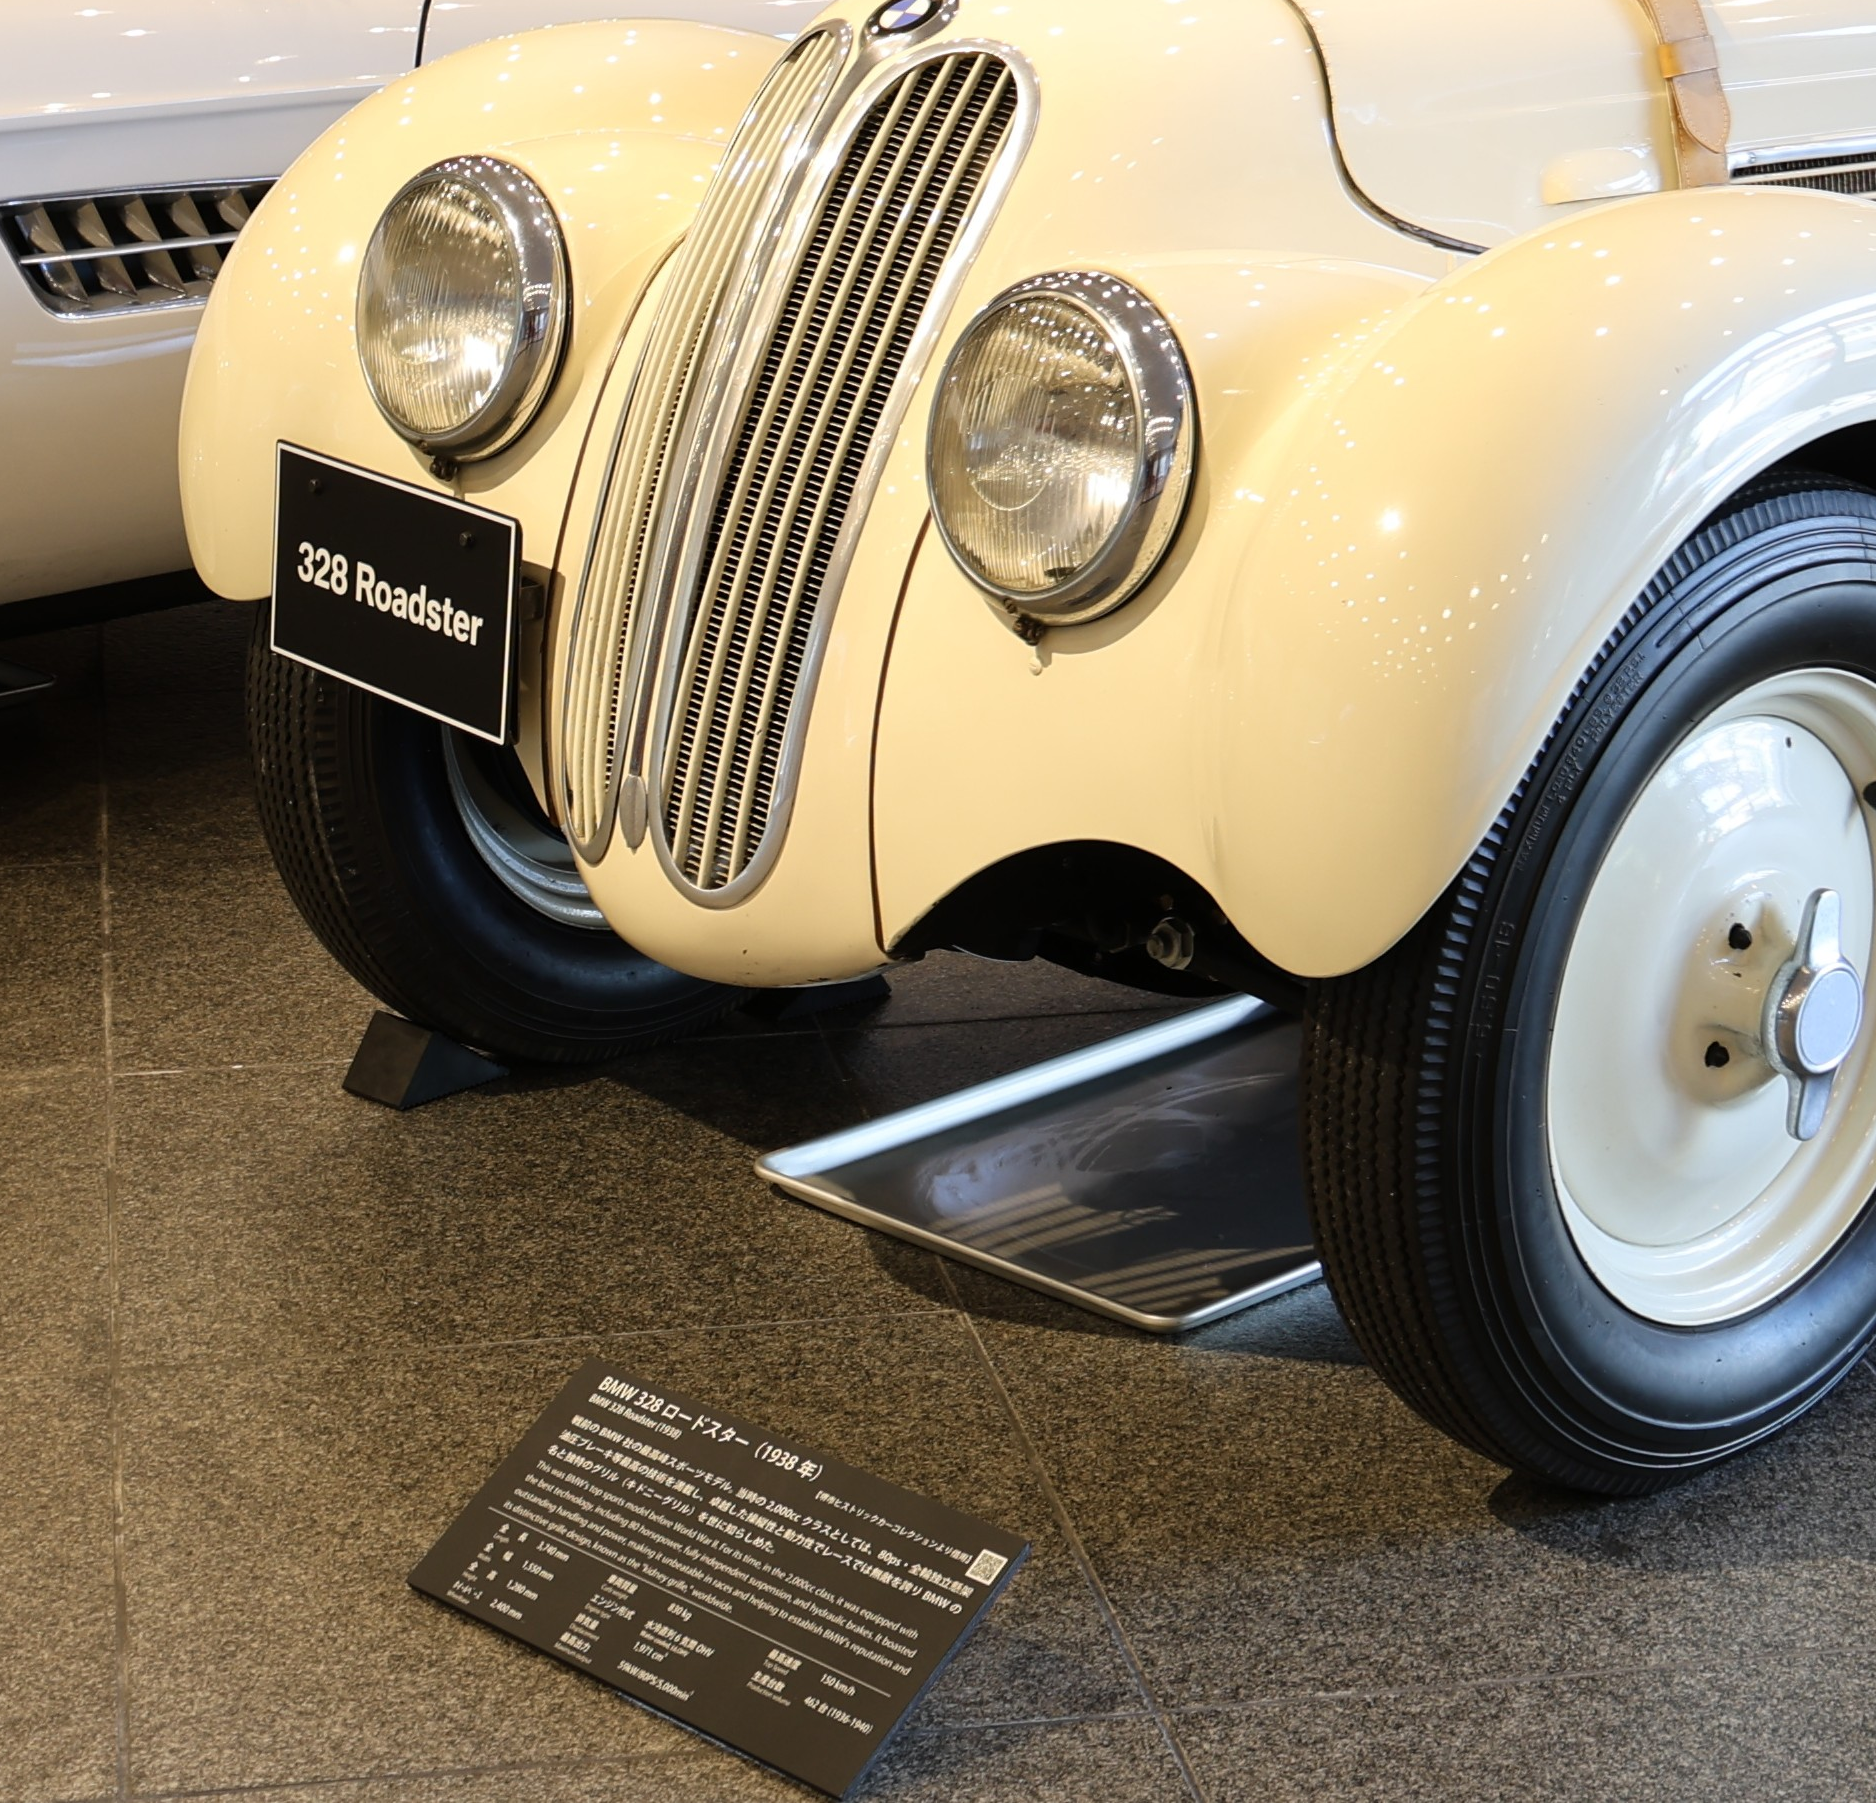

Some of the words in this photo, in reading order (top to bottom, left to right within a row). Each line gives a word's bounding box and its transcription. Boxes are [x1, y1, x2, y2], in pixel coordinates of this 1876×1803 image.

[297, 542, 347, 596] 328
[356, 561, 483, 647] Roadster
[588, 1393, 611, 1408] BMW
[607, 1401, 625, 1414] 328
[622, 1407, 657, 1428] Roadster
[654, 1422, 682, 1439] (1938)
[597, 1376, 639, 1401] BMW
[633, 1391, 664, 1412] 328
[660, 1403, 749, 1445] ロードスター
[598, 1427, 624, 1443] BMW
[765, 1500, 801, 1522] 2,000cc
[502, 1500, 513, 1510] its
[511, 1504, 549, 1526] distinctive
[546, 1522, 567, 1535] grille
[565, 1529, 591, 1547] design,
[591, 1541, 618, 1558] known
[616, 1554, 627, 1563] as
[626, 1557, 640, 1569] the
[691, 1589, 732, 1613] worldwide.
[536, 1460, 551, 1472] This
[550, 1468, 566, 1479] was
[564, 1473, 589, 1490] BMW's
[588, 1485, 603, 1496] top
[601, 1491, 625, 1506] sports
[624, 1502, 651, 1516] model
[647, 1511, 673, 1528] before
[672, 1521, 698, 1538] World
[695, 1532, 712, 1545] War
[718, 1542, 733, 1554] For
[731, 1549, 743, 1559] its
[742, 1554, 761, 1569] time,
[761, 1563, 771, 1572] in
[770, 1567, 786, 1579] the
[784, 1573, 816, 1593] 2,000cc
[814, 1588, 834, 1603] class,
[835, 1596, 844, 1605] it
[843, 1601, 860, 1613] was
[859, 1609, 901, 1630] equipped
[898, 1626, 918, 1639] with
[553, 1550, 569, 1561] mm
[524, 1474, 538, 1484] the
[537, 1478, 555, 1492] best
[552, 1487, 593, 1511] technology,
[594, 1505, 629, 1527] including
[637, 1525, 683, 1552] horsepower,
[682, 1545, 701, 1560] fully
[699, 1553, 749, 1581] independent
[747, 1577, 792, 1603] suspension,
[792, 1597, 811, 1609] and
[808, 1602, 846, 1626] hydraulic
[845, 1619, 873, 1639] brakes.
[881, 1636, 917, 1658] boasted
[538, 1570, 554, 1581] mm
[513, 1488, 557, 1513] outstanding
[555, 1505, 588, 1527] handling
[586, 1522, 605, 1533] and
[600, 1528, 627, 1545] power,
[627, 1540, 656, 1559] making
[654, 1551, 663, 1561] it
[661, 1556, 704, 1579] unbeatable
[702, 1574, 713, 1584] in
[711, 1579, 733, 1593] races
[731, 1589, 750, 1600] and
[747, 1594, 779, 1616] helping
[778, 1609, 788, 1619] to
[787, 1615, 823, 1635] establish
[822, 1629, 850, 1647] BMW's
[849, 1643, 893, 1667] reputation
[891, 1663, 911, 1675] and
[522, 1589, 538, 1600] mm
[921, 1590, 951, 1608] BMW
[489, 1598, 510, 1613] 2,400
[507, 1608, 522, 1619] mm
[667, 1602, 683, 1615] 830
[681, 1608, 692, 1621] kg
[633, 1641, 653, 1656] 1,971
[820, 1673, 836, 1686] 150
[833, 1679, 855, 1696] km/h
[804, 1696, 820, 1709] 462
